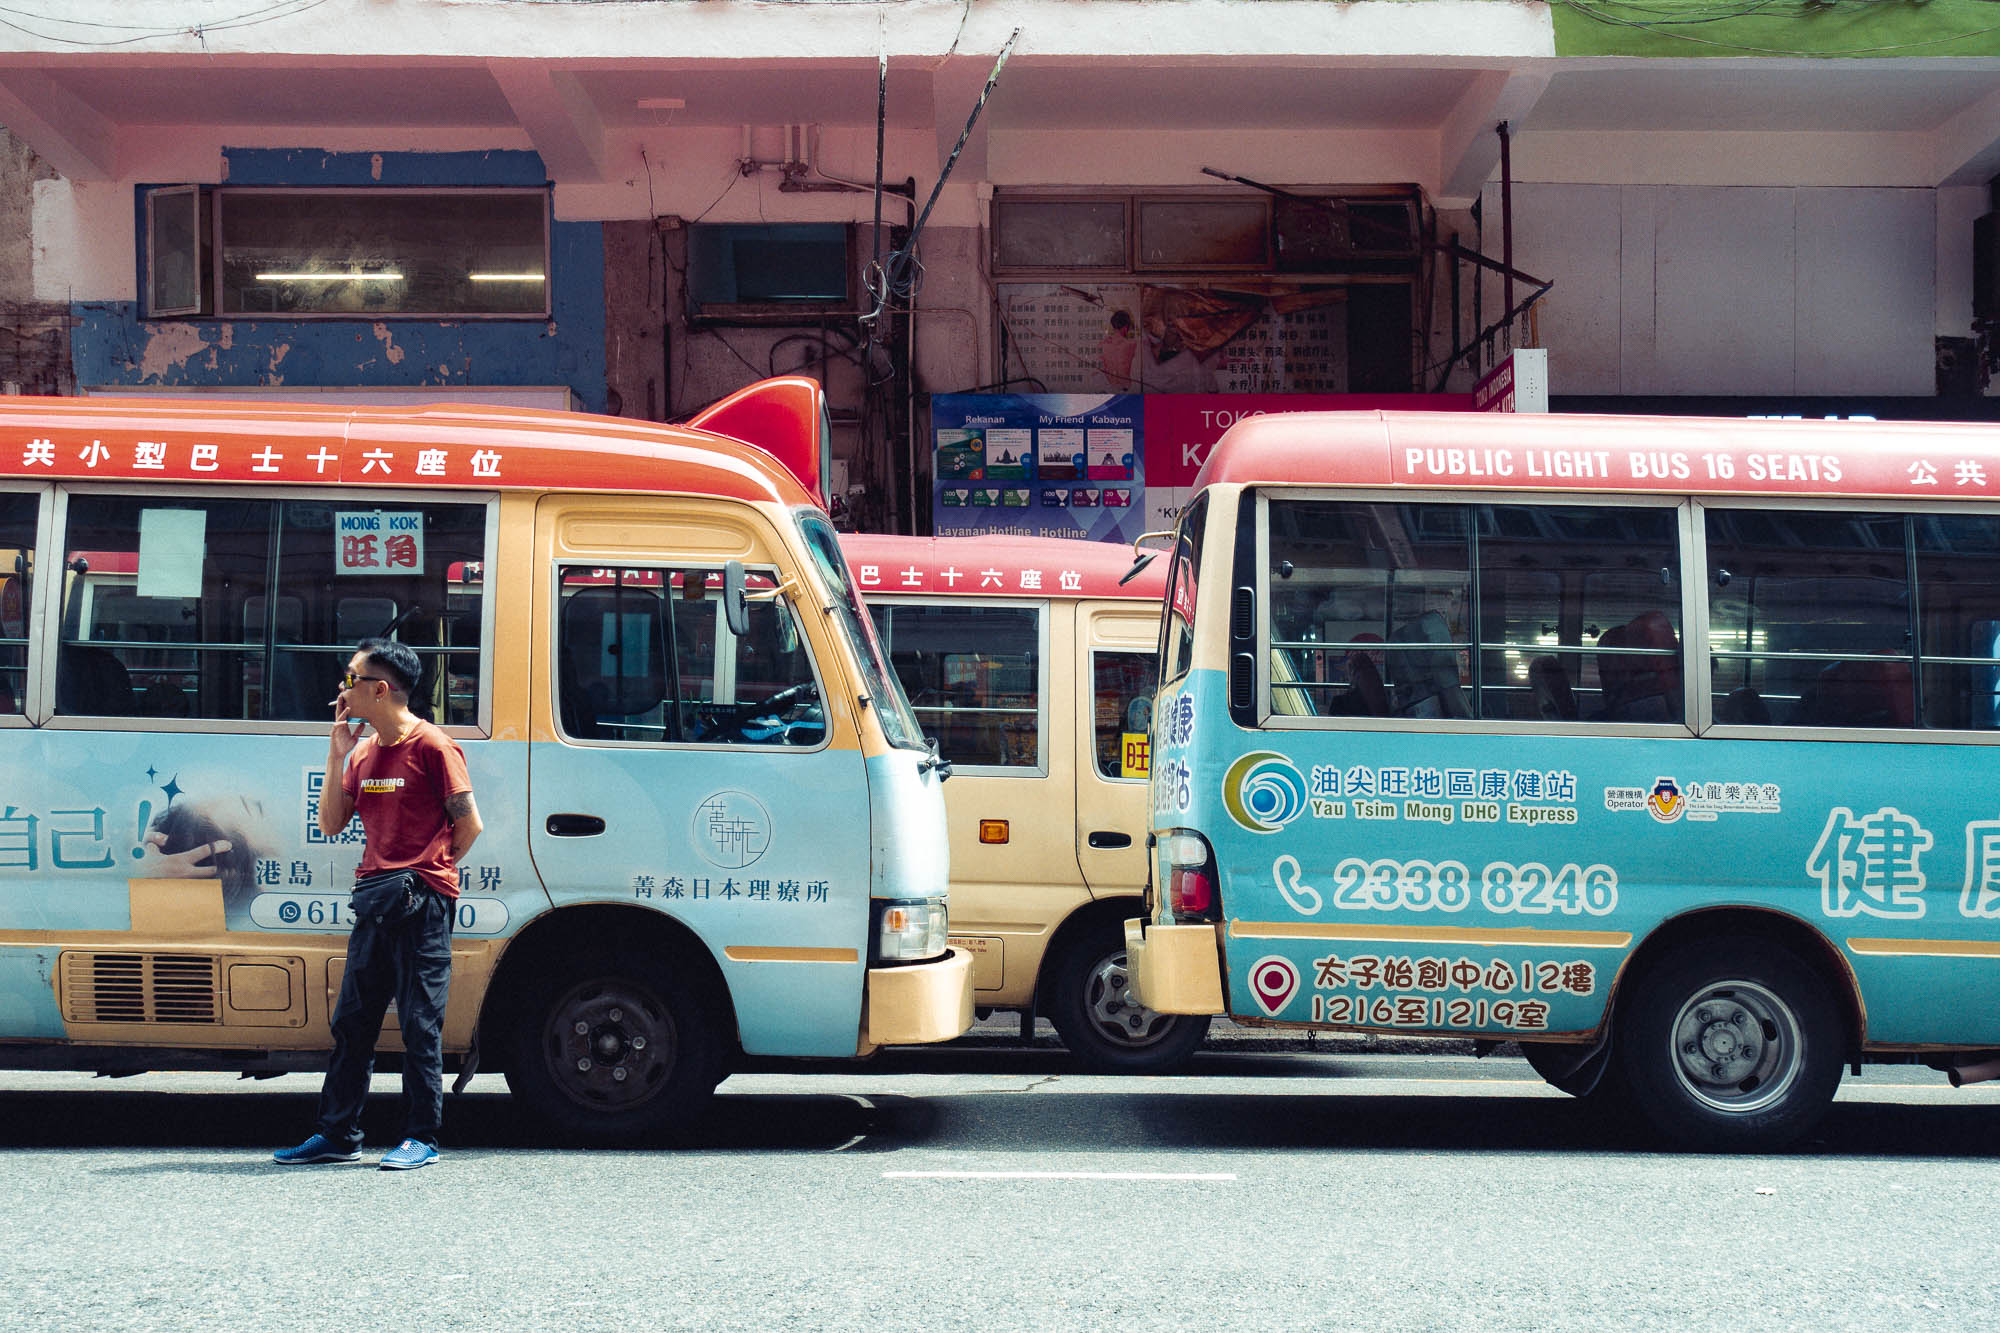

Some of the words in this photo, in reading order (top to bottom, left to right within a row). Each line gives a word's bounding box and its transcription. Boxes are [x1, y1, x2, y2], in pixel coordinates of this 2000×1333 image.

[965, 415, 1005, 424] Rekanan
[1039, 416, 1053, 425] My
[1055, 415, 1084, 424] Friend
[1092, 415, 1132, 425] Kabayan
[22, 438, 503, 478] 共小型巴士十六座位
[1405, 447, 1513, 477] PUBLIC
[1526, 450, 1610, 479] LIGHT
[1630, 452, 1690, 480] BUS
[1701, 454, 1734, 480] 16
[1748, 454, 1842, 483] SEATS
[1906, 459, 1987, 486] 公共
[341, 516, 380, 530] MONG
[390, 516, 418, 530] KOK
[989, 526, 1031, 536] Hotline
[1040, 528, 1088, 538] Hotline
[342, 534, 418, 568] 旺角
[860, 566, 1082, 590] 巴士十六座位
[1126, 742, 1150, 771] 旺
[360, 778, 405, 788] NOTHING
[1312, 766, 1577, 800] 油尖旺地區康健站
[1606, 789, 1643, 800] 營運機構
[1688, 784, 1779, 802] 九龍樂善堂
[1312, 801, 1344, 819] Yau
[1356, 802, 1395, 819] Tsim
[1406, 804, 1452, 822] Mong
[1464, 804, 1498, 820] DHC
[1509, 805, 1577, 824] Express
[1606, 798, 1644, 809] Operator
[256, 859, 312, 886] 港島
[632, 874, 830, 903] 菁森日本理療所
[1334, 858, 1470, 912] 2338
[1482, 862, 1618, 915] 8246
[1316, 956, 1596, 994] 太子始創中心12樓
[1312, 997, 1548, 1028] 1216至1219室
